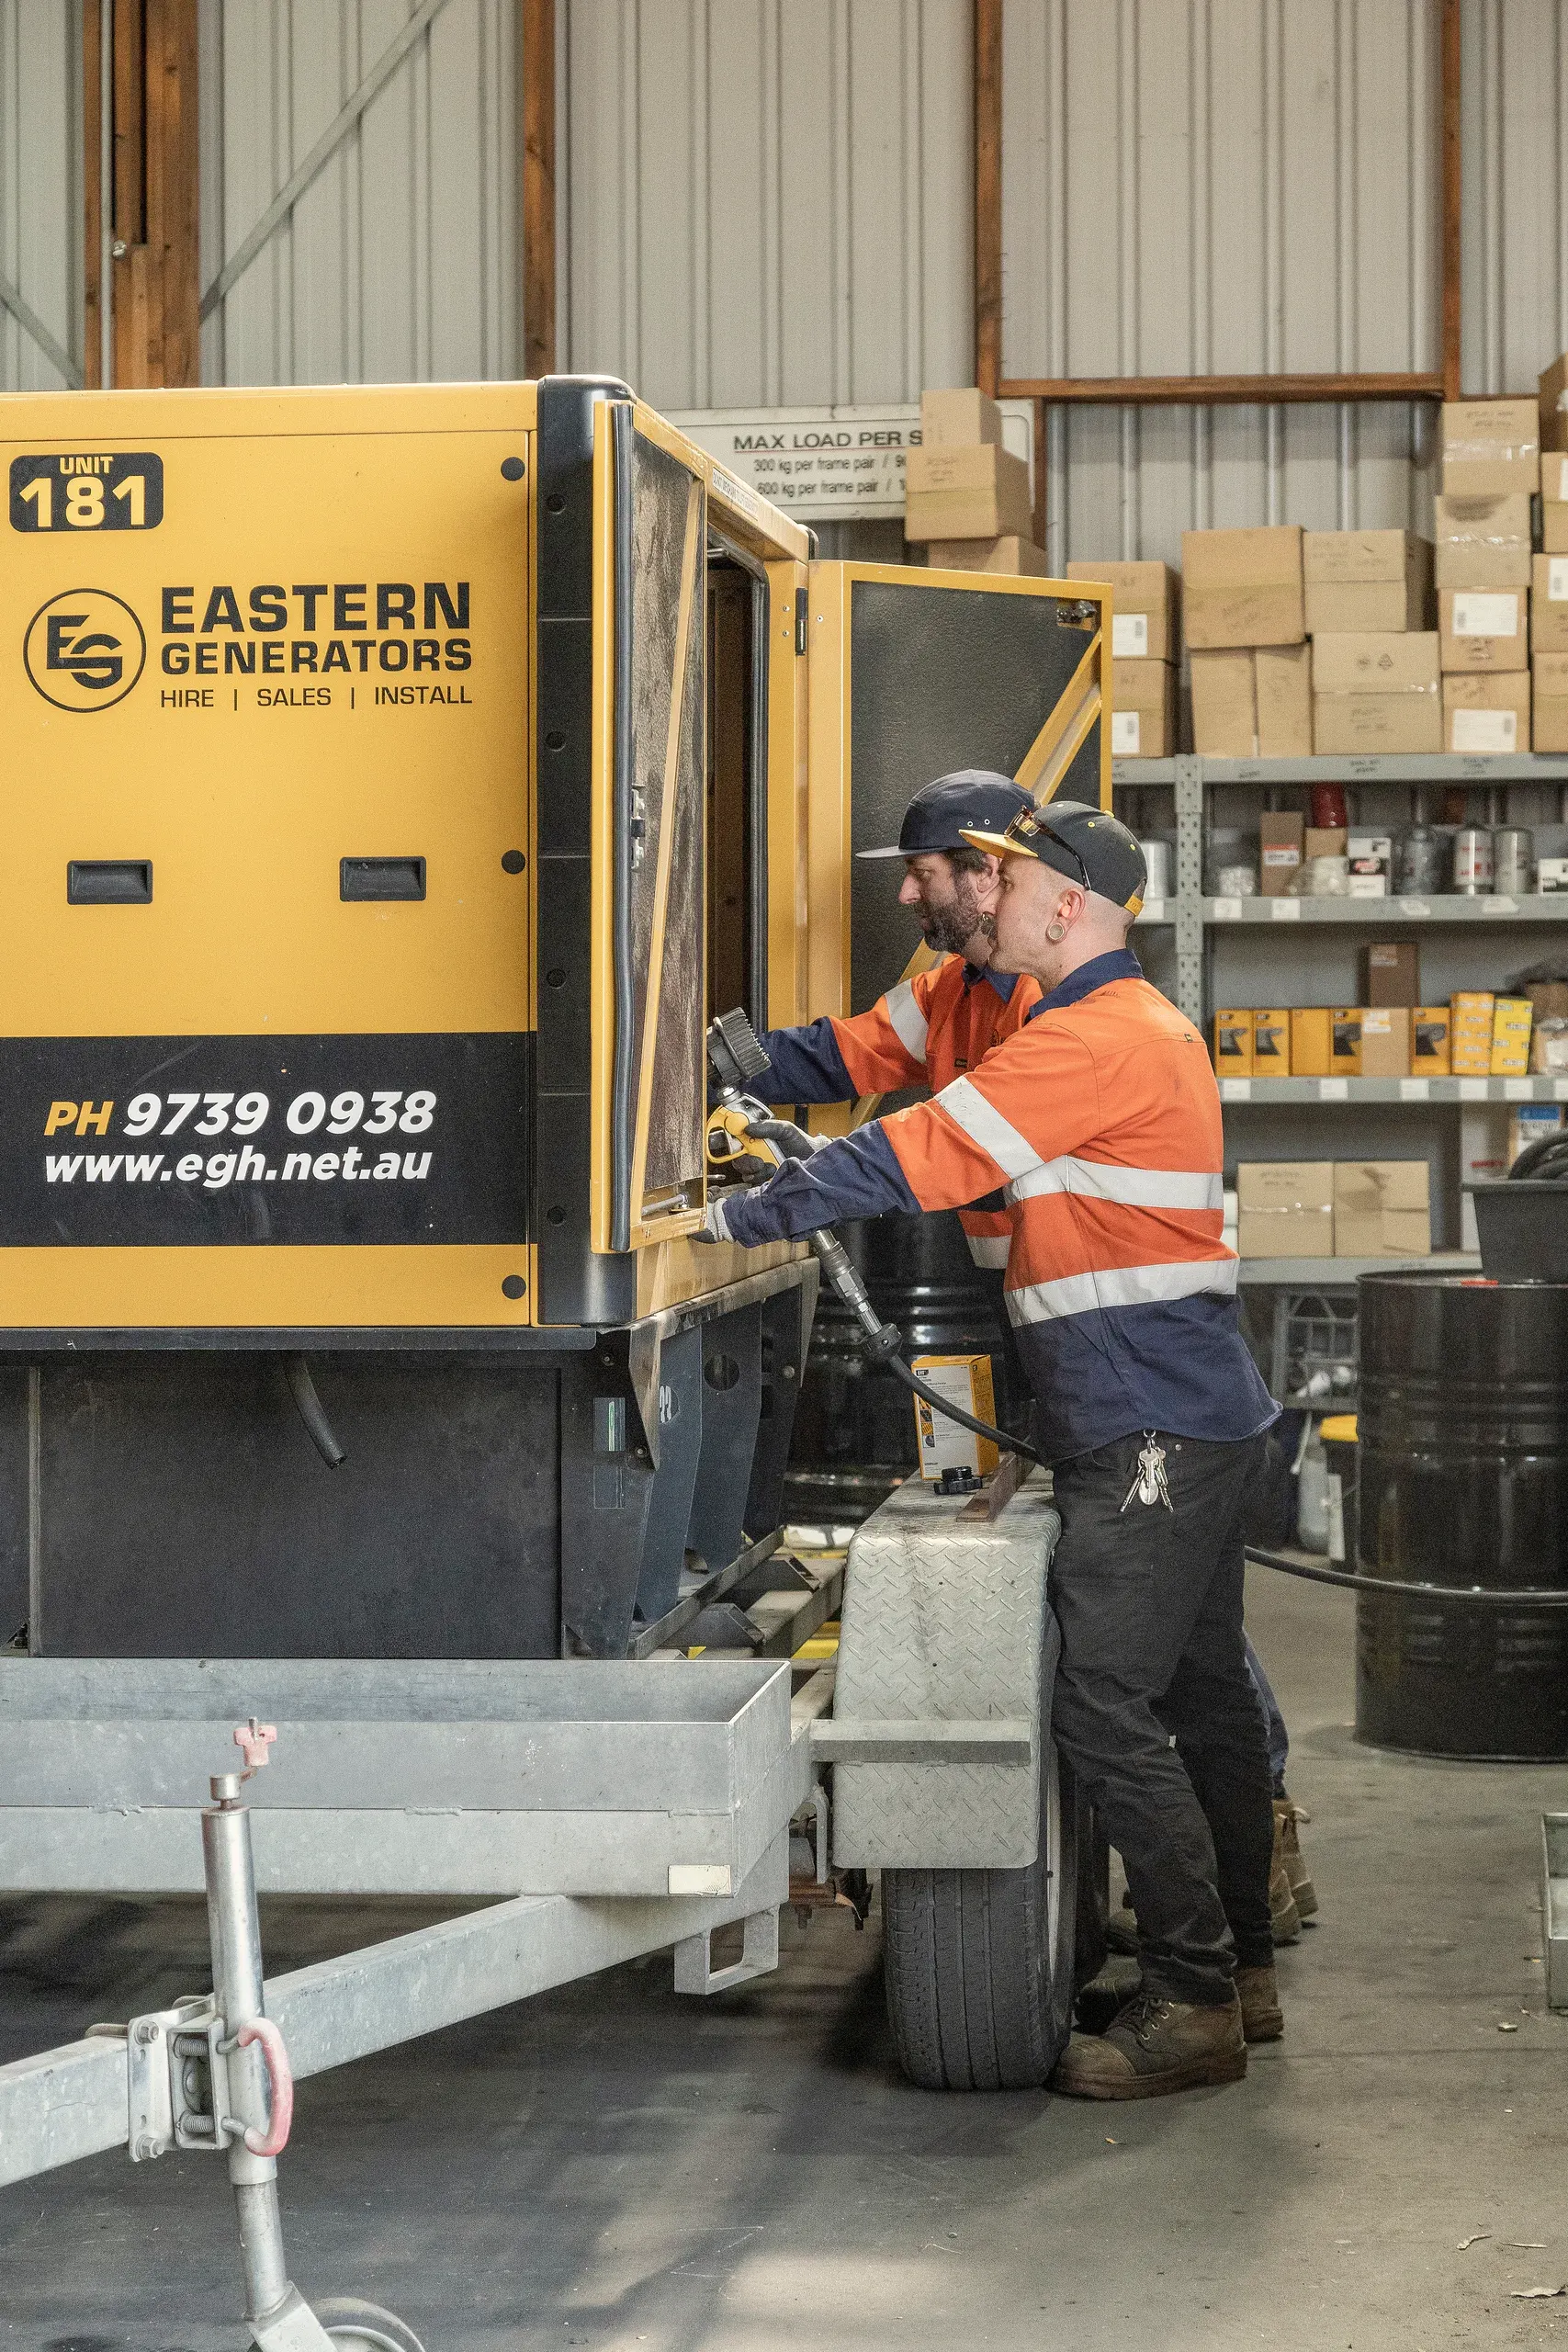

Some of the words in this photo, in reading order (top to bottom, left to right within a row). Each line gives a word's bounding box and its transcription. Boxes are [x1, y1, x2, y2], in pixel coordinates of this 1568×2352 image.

[734, 435, 784, 450] MAX
[794, 433, 852, 448] LOAD
[859, 431, 901, 447] PER
[908, 430, 923, 446] S
[60, 457, 113, 474] UNIT
[754, 458, 775, 472] 300
[779, 458, 792, 475] kg
[795, 459, 813, 474] per
[818, 456, 850, 470] frame
[853, 455, 874, 473] pair
[19, 475, 145, 528] 181
[782, 481, 795, 498] kg
[798, 481, 817, 497] per
[821, 479, 853, 493] frame
[857, 479, 878, 496] pair
[162, 582, 469, 633] EASTERN
[162, 639, 471, 675] GENERATORS
[161, 689, 214, 708] HIRE
[257, 687, 332, 707] SALES
[375, 685, 472, 705] INSTALL
[44, 1102, 113, 1136] PH
[122, 1091, 269, 1136] 9739
[287, 1091, 436, 1135] 0938
[46, 1146, 433, 1189] www.egh.net.au
